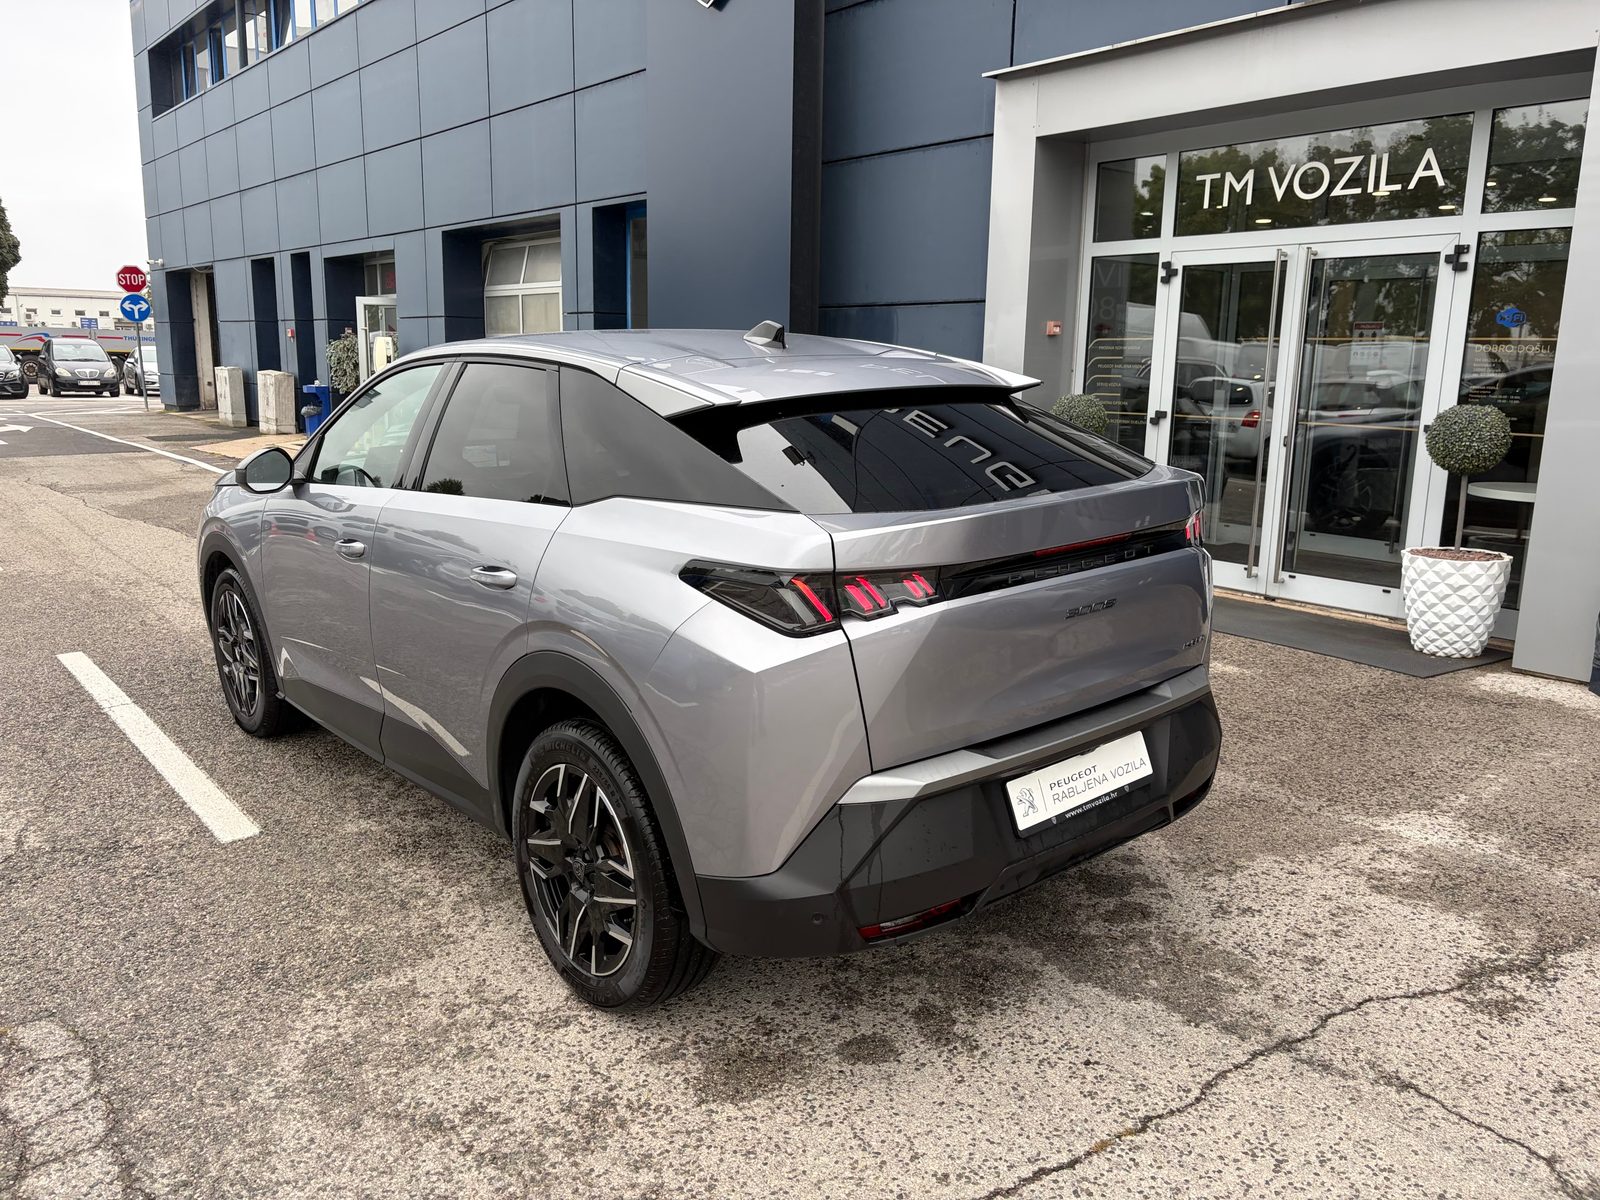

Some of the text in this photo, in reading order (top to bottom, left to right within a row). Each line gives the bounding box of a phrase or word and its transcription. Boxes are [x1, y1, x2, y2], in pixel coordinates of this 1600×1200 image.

[1195, 147, 1447, 209] TM VOZILA
[118, 273, 145, 286] STOP
[1475, 342, 1551, 353] DOBRO DOŠLI
[1049, 765, 1097, 791] PEUGEOT
[1052, 757, 1147, 805] RABLJENA VOZILA
[1064, 791, 1118, 819] www.tmvozila.hr
